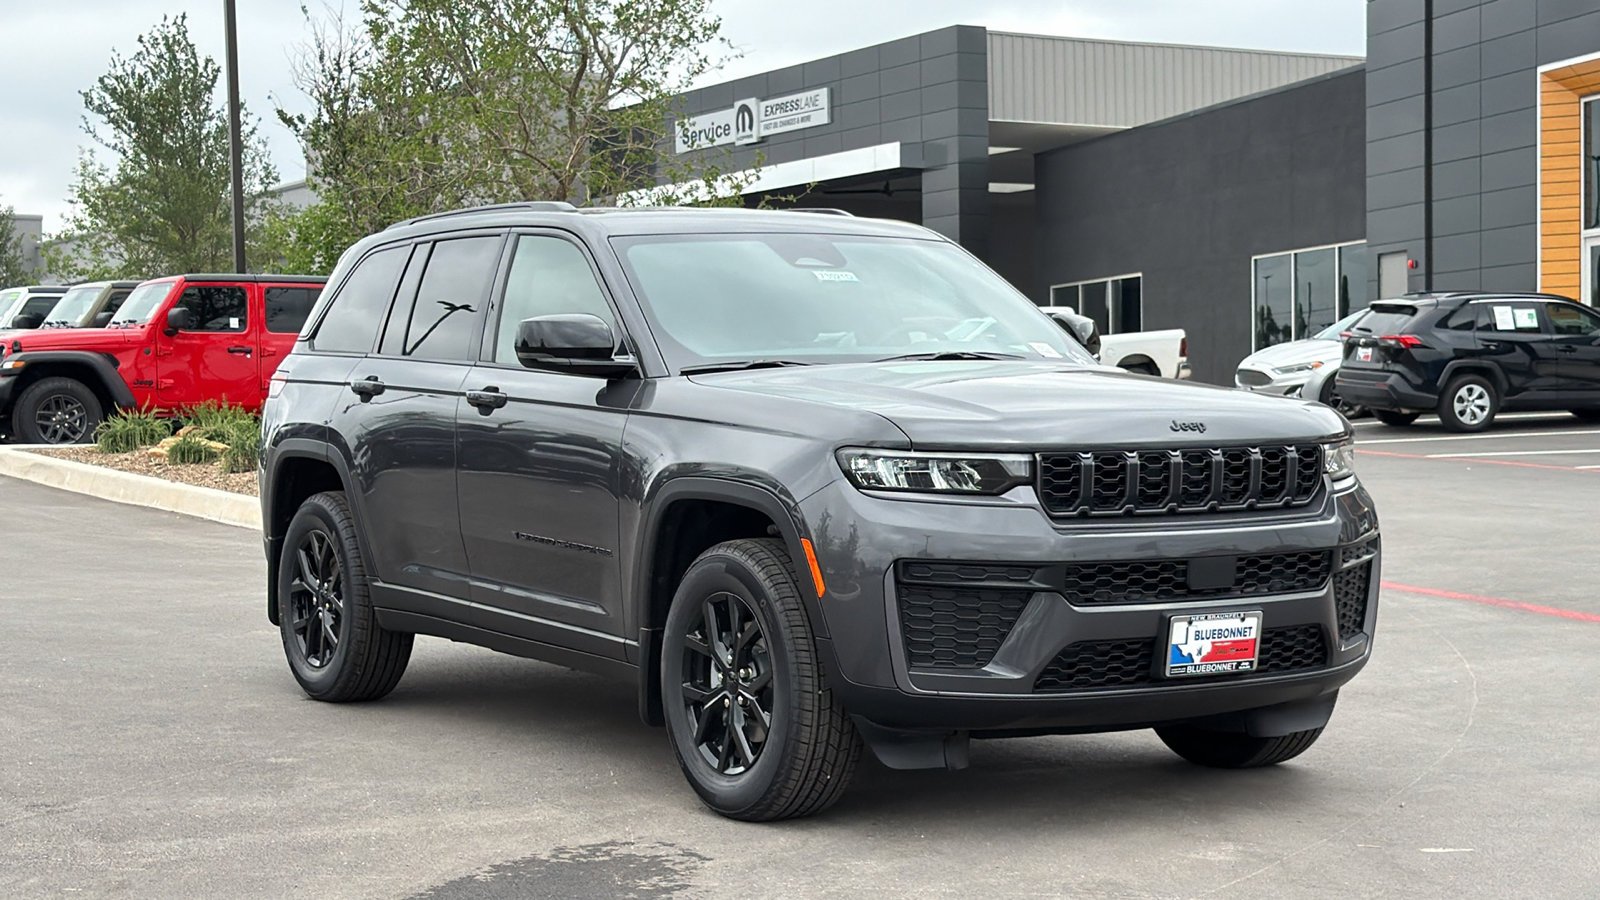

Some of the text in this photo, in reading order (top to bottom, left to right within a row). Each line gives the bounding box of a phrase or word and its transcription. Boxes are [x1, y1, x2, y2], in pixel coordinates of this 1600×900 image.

[764, 94, 819, 117] EXPRESSLANE
[682, 122, 731, 145] Service
[1170, 420, 1207, 433] Jeep
[1194, 627, 1253, 640] BLUEBONNET
[1187, 662, 1237, 673] BLUEBONNET
